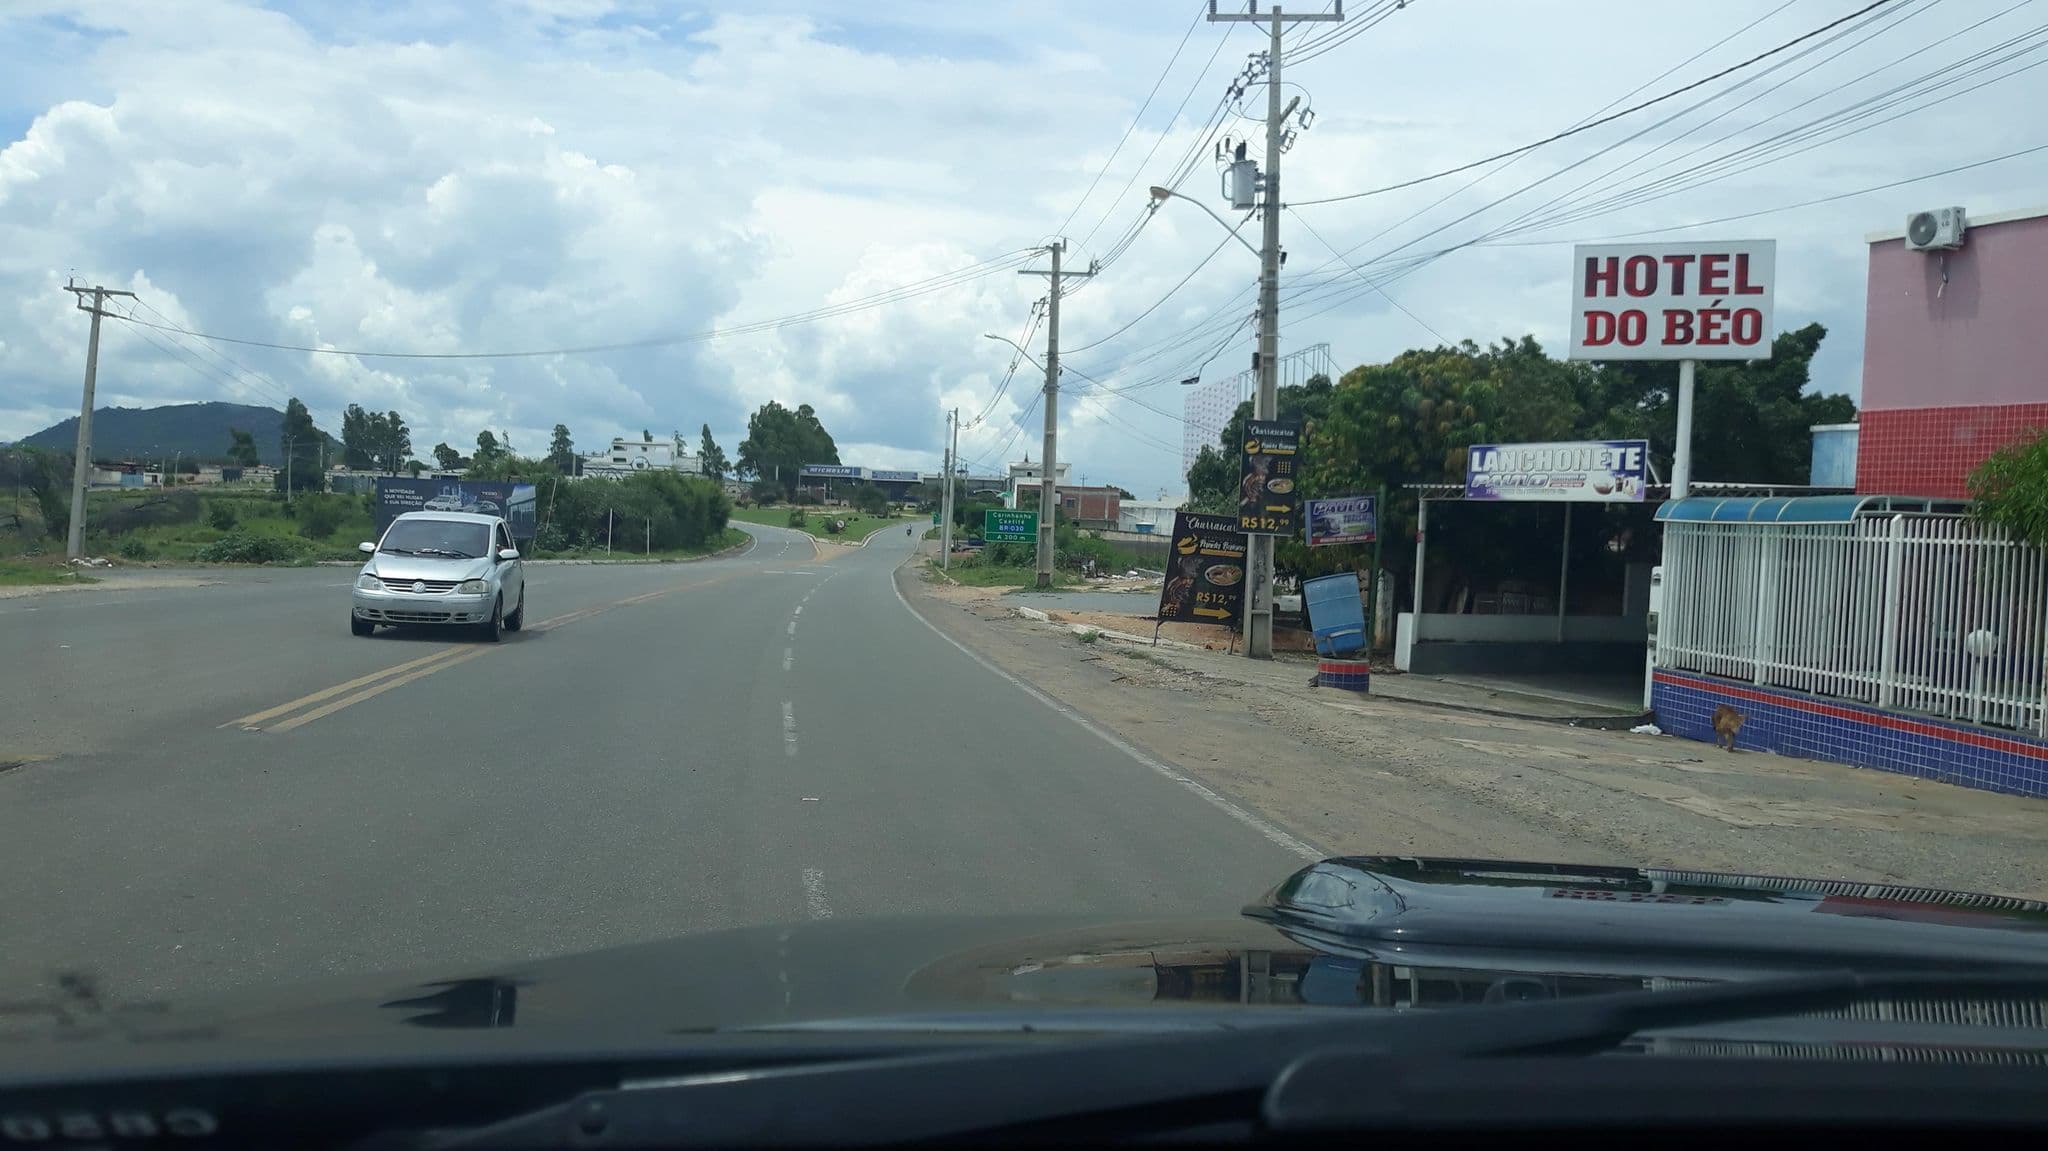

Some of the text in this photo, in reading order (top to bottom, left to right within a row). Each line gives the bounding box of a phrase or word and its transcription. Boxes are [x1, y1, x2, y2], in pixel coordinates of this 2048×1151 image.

[1584, 253, 1764, 298] HOTEL
[1582, 299, 1763, 346] DO BÉO
[1471, 447, 1641, 472] LANCHONETE
[1471, 474, 1550, 488] PAULO
[1312, 500, 1370, 515] PAULO
